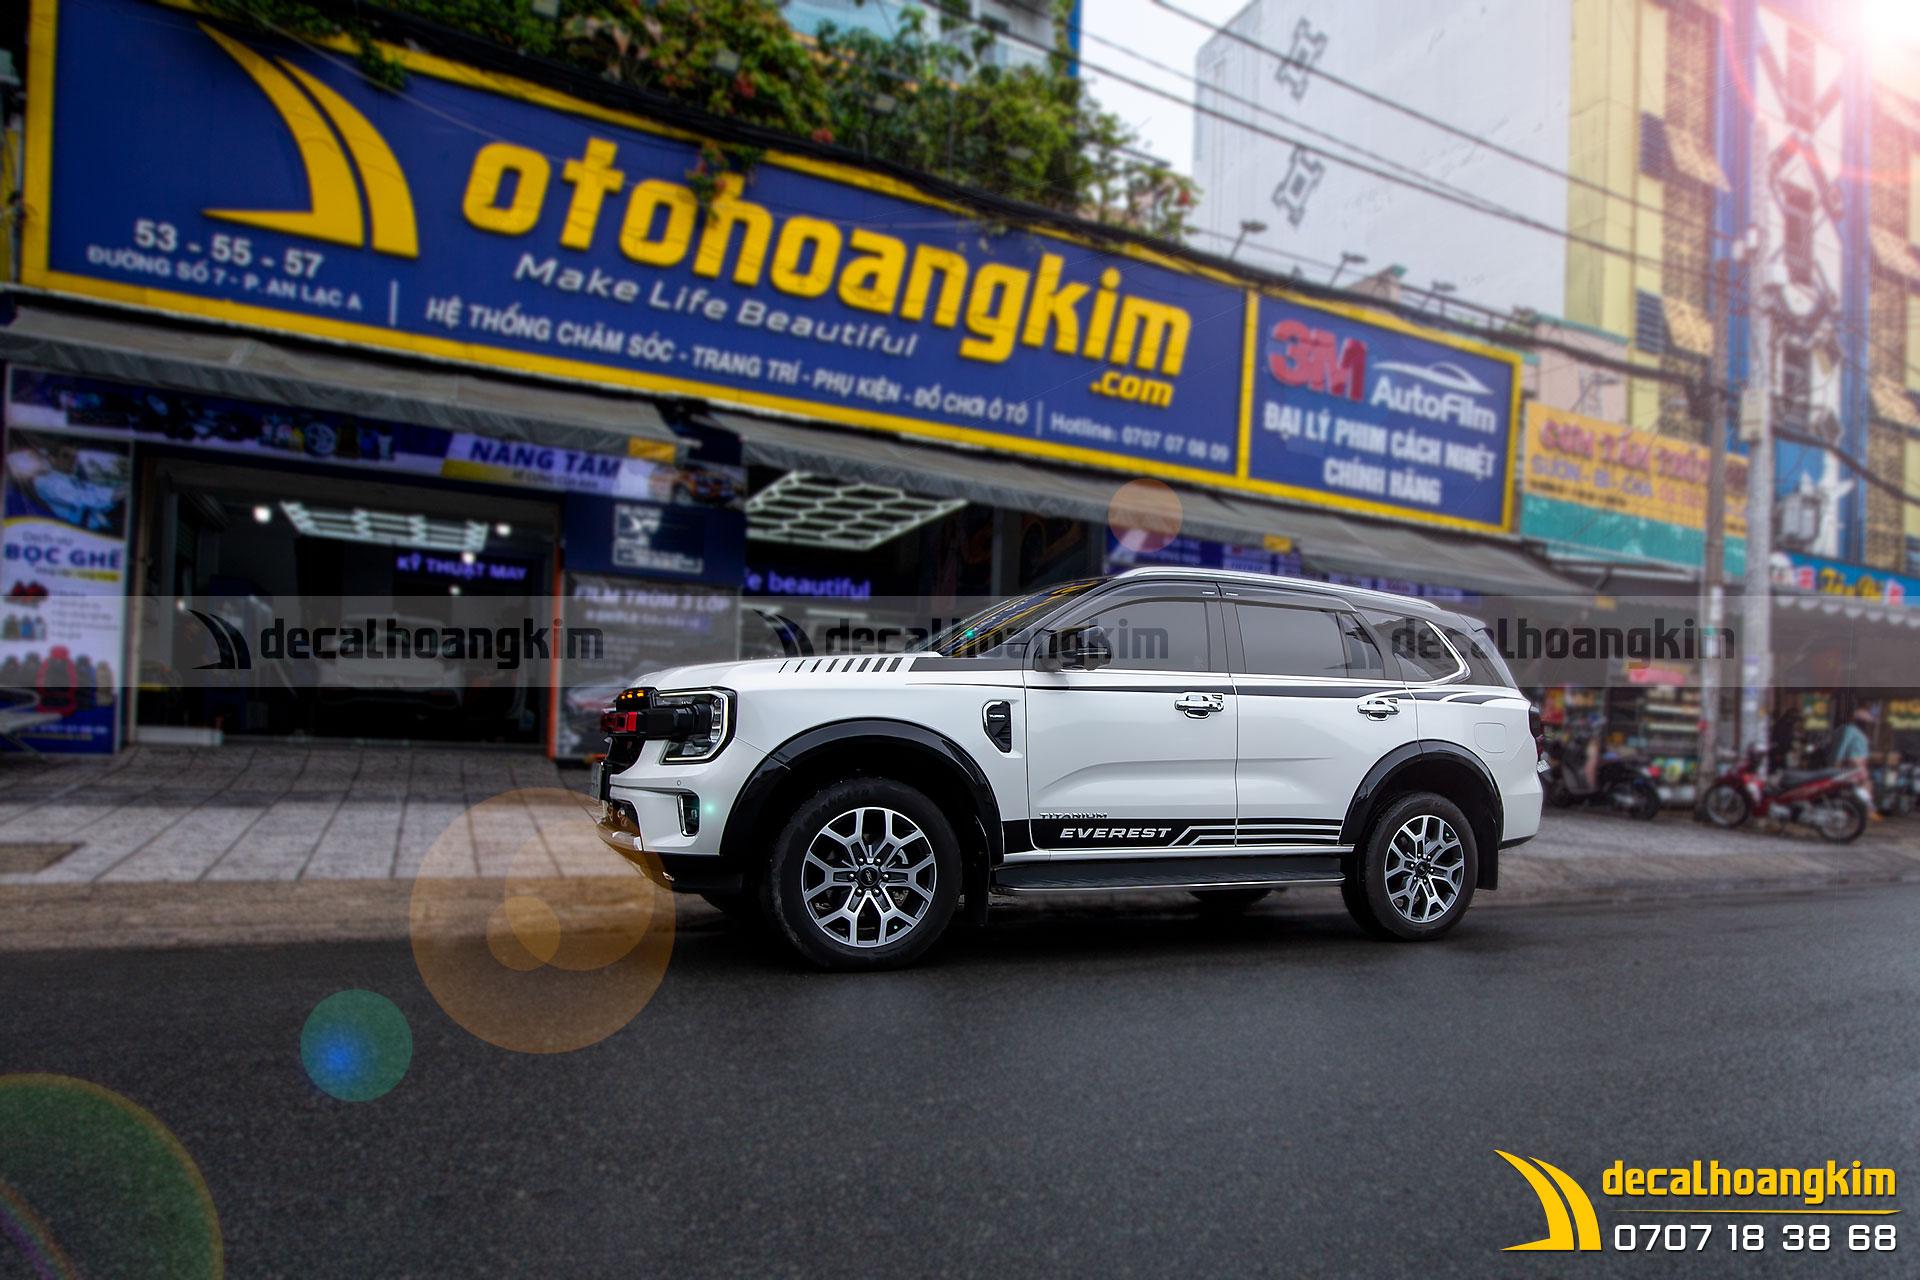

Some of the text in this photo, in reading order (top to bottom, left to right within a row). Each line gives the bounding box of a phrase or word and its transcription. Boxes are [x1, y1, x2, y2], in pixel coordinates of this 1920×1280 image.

[135, 219, 178, 251] 53
[211, 234, 252, 266] 55
[284, 249, 324, 279] 57
[462, 136, 1193, 375] otohoangkim
[175, 258, 209, 283] SỐ
[301, 285, 342, 309] LẠC
[346, 293, 363, 311] A
[513, 253, 919, 357] Make Life Beautiful
[425, 294, 463, 328] HỆ
[468, 302, 551, 341] THỐNG
[628, 331, 676, 363] SÓC
[691, 346, 762, 379] TRANG
[767, 359, 803, 386] TRÍ
[812, 368, 855, 398] PHỤ
[857, 375, 902, 405] KIỆN
[1268, 319, 1367, 403] 3M
[1090, 371, 1175, 408] .com
[1370, 376, 1498, 434] AutoFilm
[1051, 413, 1118, 442] Hotline:
[1122, 425, 1162, 449] 0707
[1164, 434, 1184, 454] 07
[1263, 400, 1302, 440] ĐẠI
[1305, 408, 1332, 442] LÝ
[1334, 416, 1388, 456] PHIM
[1391, 428, 1442, 467] CÁCH
[1324, 456, 1386, 495] CHÍNH
[5, 542, 61, 567] BỌC
[768, 571, 871, 601] beautiful
[1060, 827, 1172, 840] EVEREST
